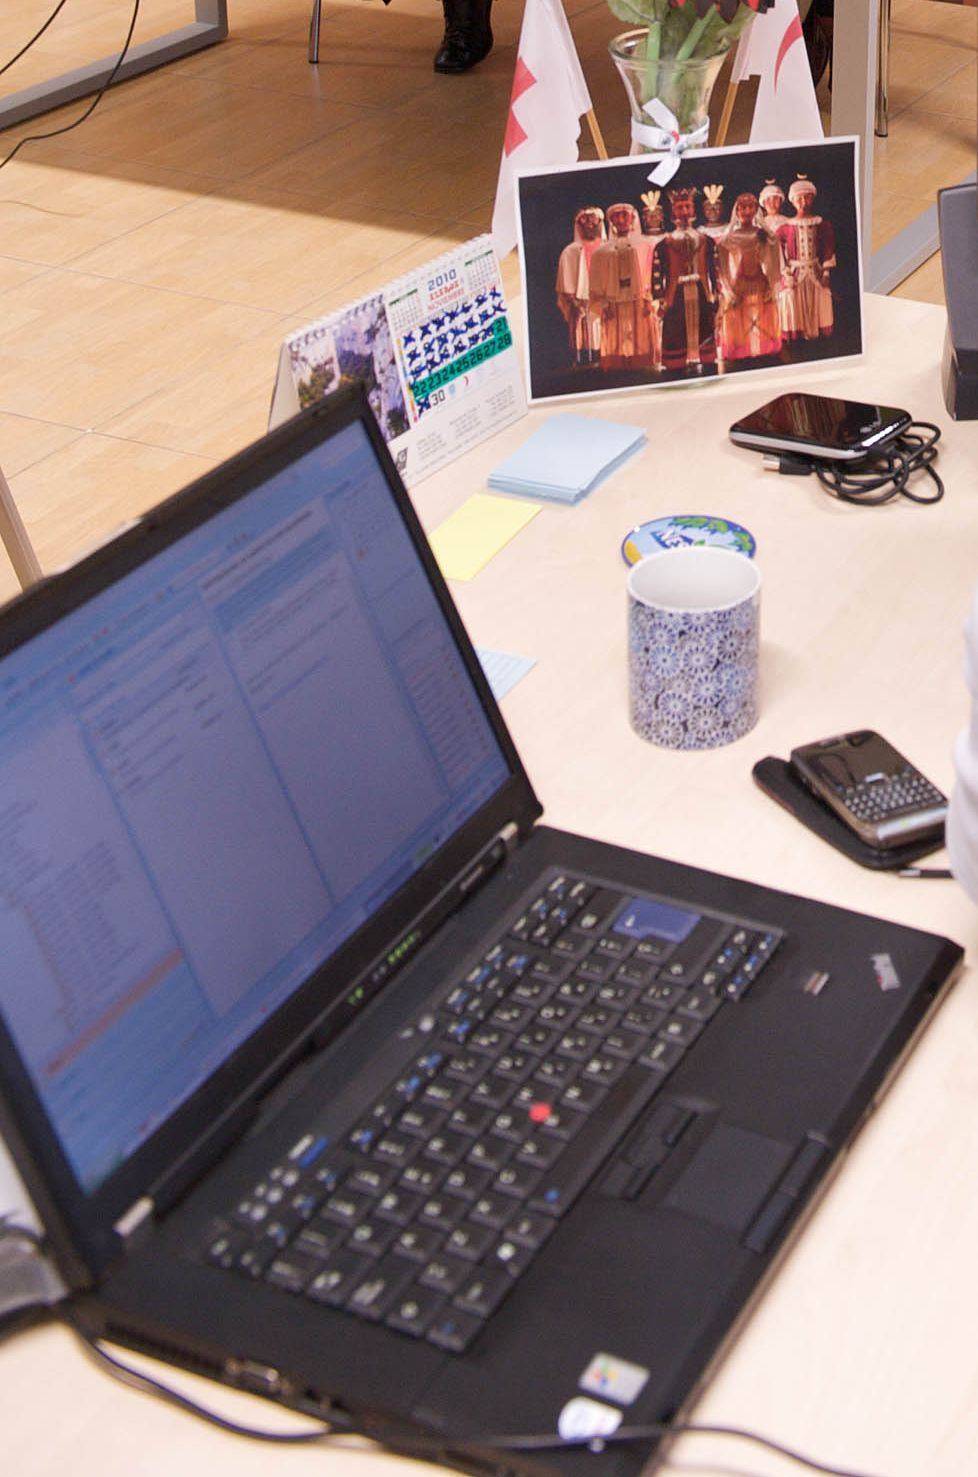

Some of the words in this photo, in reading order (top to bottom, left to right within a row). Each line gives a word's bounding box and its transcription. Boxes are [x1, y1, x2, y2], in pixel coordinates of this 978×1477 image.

[427, 268, 457, 291] 2010
[495, 317, 508, 333] 21
[413, 380, 428, 398] 22
[427, 372, 442, 390] 23
[442, 365, 456, 381] 24
[455, 357, 470, 373] 25
[470, 349, 484, 365] 26
[483, 340, 496, 356] 27
[497, 332, 511, 349] 28
[431, 389, 446, 406] 30
